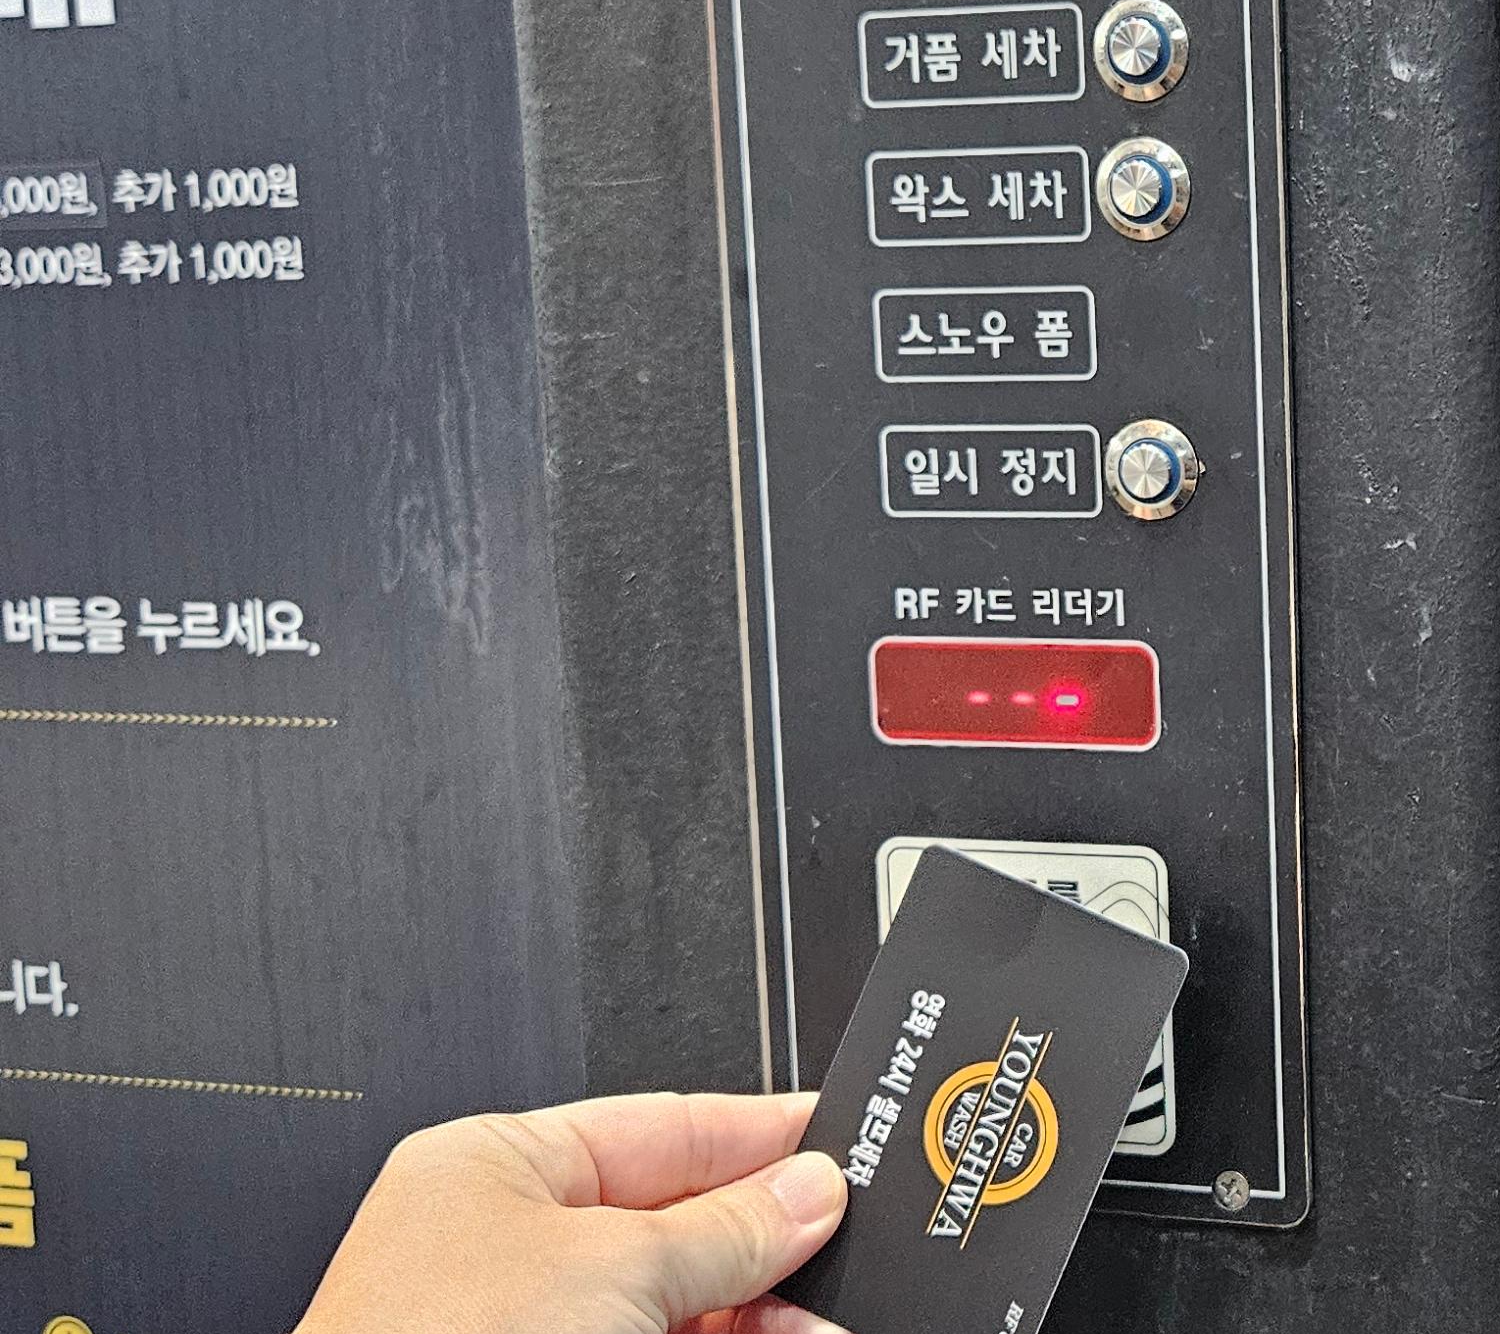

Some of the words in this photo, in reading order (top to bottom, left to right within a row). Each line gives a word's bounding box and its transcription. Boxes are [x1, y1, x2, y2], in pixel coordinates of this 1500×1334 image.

[885, 33, 961, 83] 거품
[981, 27, 1061, 79] 세차
[112, 168, 177, 213] 추가
[184, 163, 299, 212] 1,000원
[890, 172, 969, 223] 왁스
[988, 170, 1067, 220] 세차
[117, 239, 183, 285] 추가
[189, 235, 305, 285] 1,000원
[898, 310, 1014, 359] 스노우
[1035, 310, 1073, 358] 폼
[905, 448, 979, 496] 일시
[1001, 448, 1076, 497] 정지
[2, 595, 127, 654] 버튼을
[895, 588, 940, 620] RF
[956, 587, 1017, 624] 카드
[1032, 588, 1126, 627] 리더기
[902, 990, 946, 1040] 영화
[878, 1037, 923, 1095] 24시
[930, 1029, 1044, 1238] YOUNGHWA
[944, 1092, 981, 1150] WASH
[1003, 1123, 1033, 1167] CAR
[1004, 1300, 1024, 1334] RF
